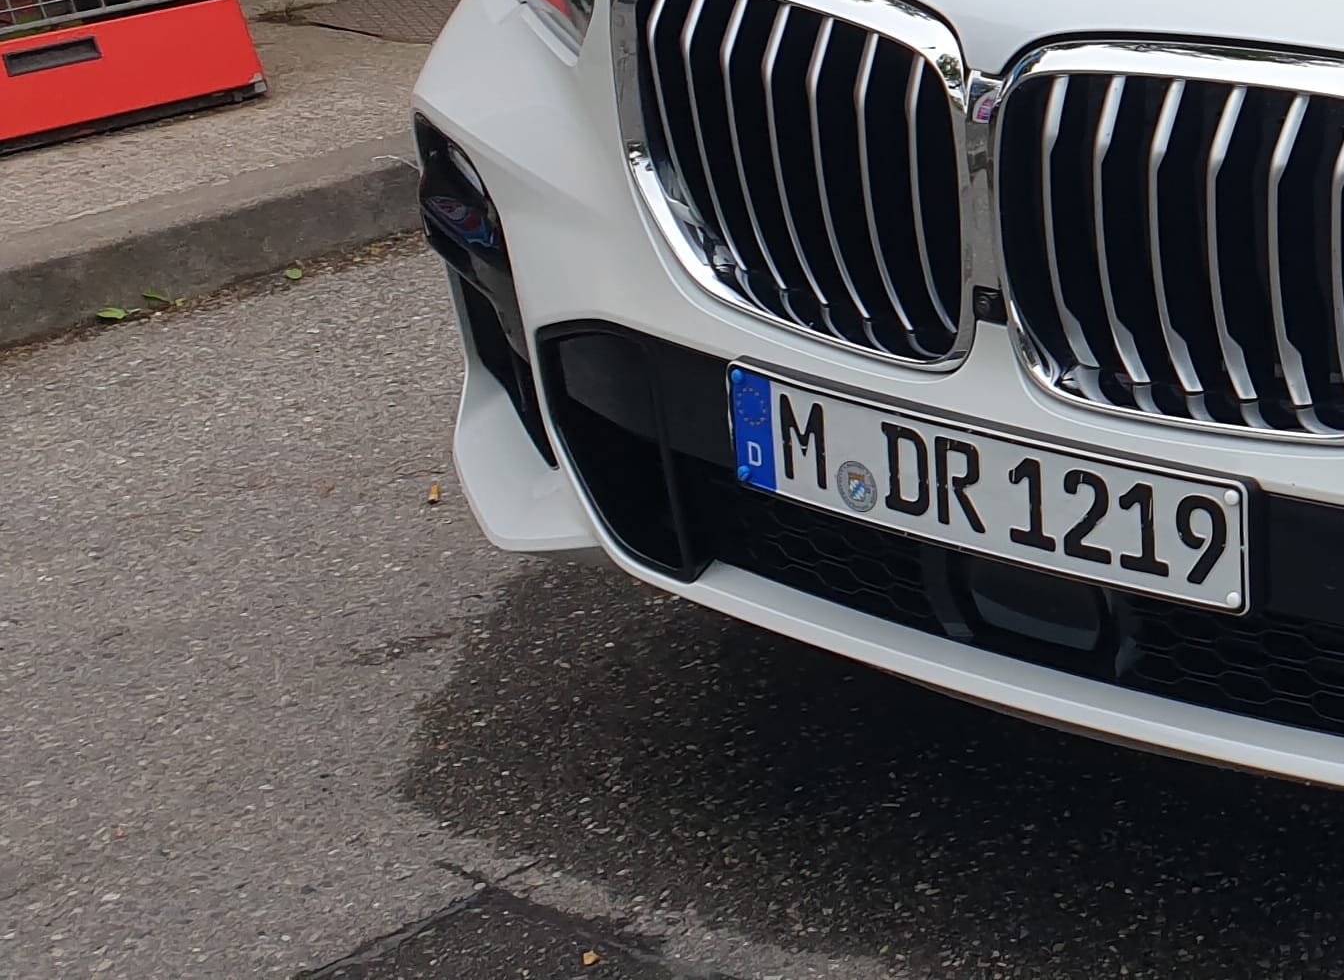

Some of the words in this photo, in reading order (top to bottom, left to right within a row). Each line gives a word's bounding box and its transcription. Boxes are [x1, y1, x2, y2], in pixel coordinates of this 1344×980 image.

[746, 440, 763, 468] D
[778, 393, 828, 490] M
[881, 420, 986, 534] DR
[1008, 457, 1228, 585] 1219
